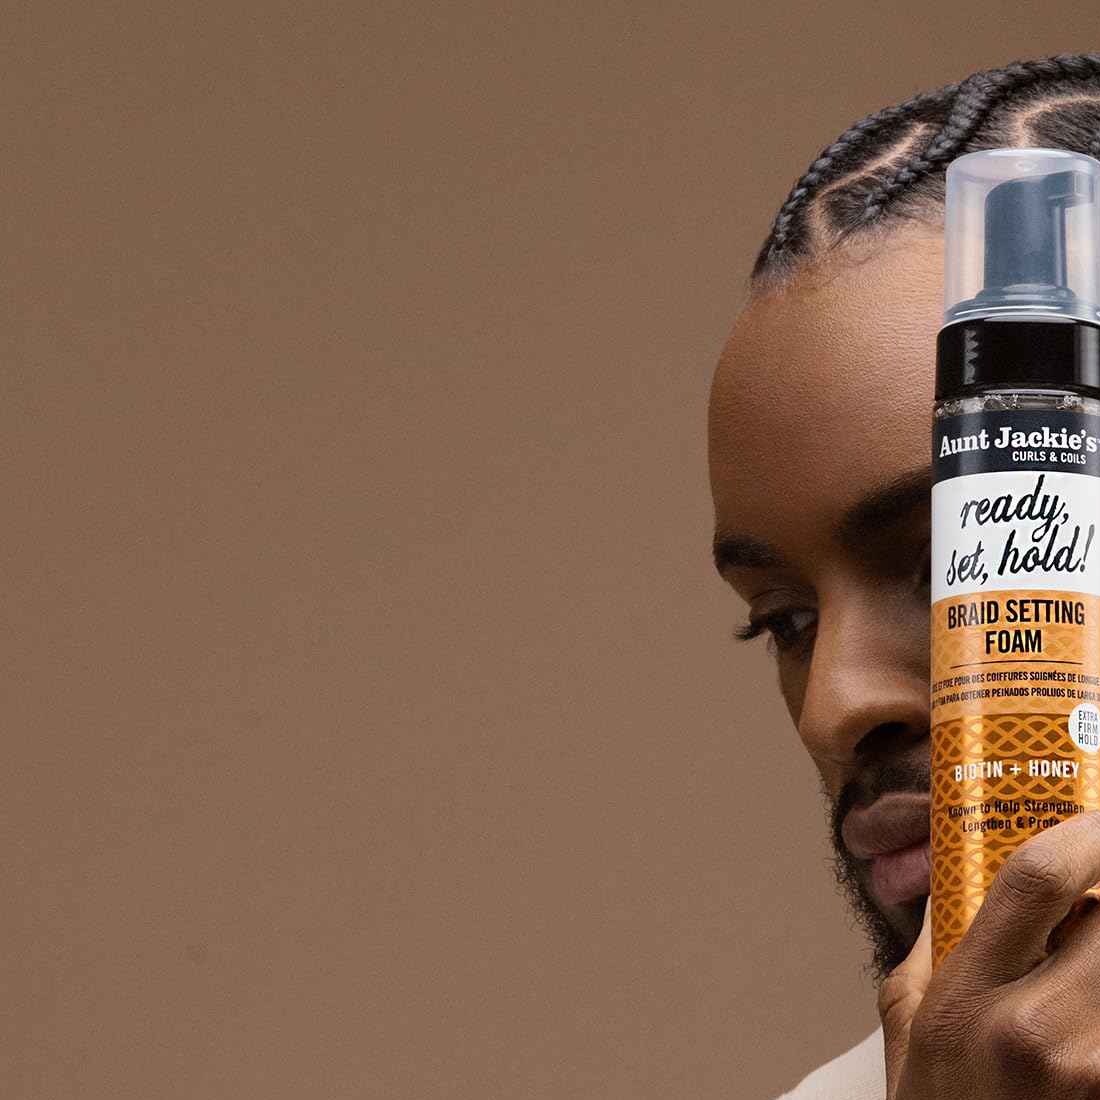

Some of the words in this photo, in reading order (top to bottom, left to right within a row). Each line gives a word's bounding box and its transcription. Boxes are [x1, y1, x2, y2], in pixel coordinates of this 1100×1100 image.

[940, 429, 990, 457] Aunt
[1012, 451, 1046, 462] CURLS
[1049, 451, 1058, 462] &
[1060, 452, 1087, 464] COILS
[960, 474, 1069, 542] ready,
[946, 540, 989, 586] set,
[997, 524, 1095, 576] hold!
[948, 600, 999, 630] BRAID
[1005, 599, 1085, 625] SETTING
[985, 629, 1042, 654] FOAM
[954, 675, 970, 687] POUR
[972, 673, 985, 683] DES
[986, 671, 1028, 682] COIFFURES
[1029, 670, 1066, 682] SOIGNÉES
[1068, 673, 1076, 682] DE
[946, 693, 960, 704] PARA
[960, 689, 990, 701] OBTENER
[992, 687, 1029, 697] PEINADOS
[1067, 689, 1076, 698] DE
[1077, 690, 1096, 701] LARGA
[1078, 710, 1098, 722] EXTRA
[1078, 722, 1098, 733] FIRM
[1078, 733, 1098, 746] HOLD
[955, 761, 1003, 782] BIOTIN
[1028, 760, 1080, 779] HONEY
[948, 806, 976, 819] Known
[980, 802, 990, 814] to
[994, 800, 1020, 814] Help
[1024, 800, 1085, 814] Strengthen
[962, 817, 1011, 833] Lengthen
[1016, 816, 1024, 829] &
